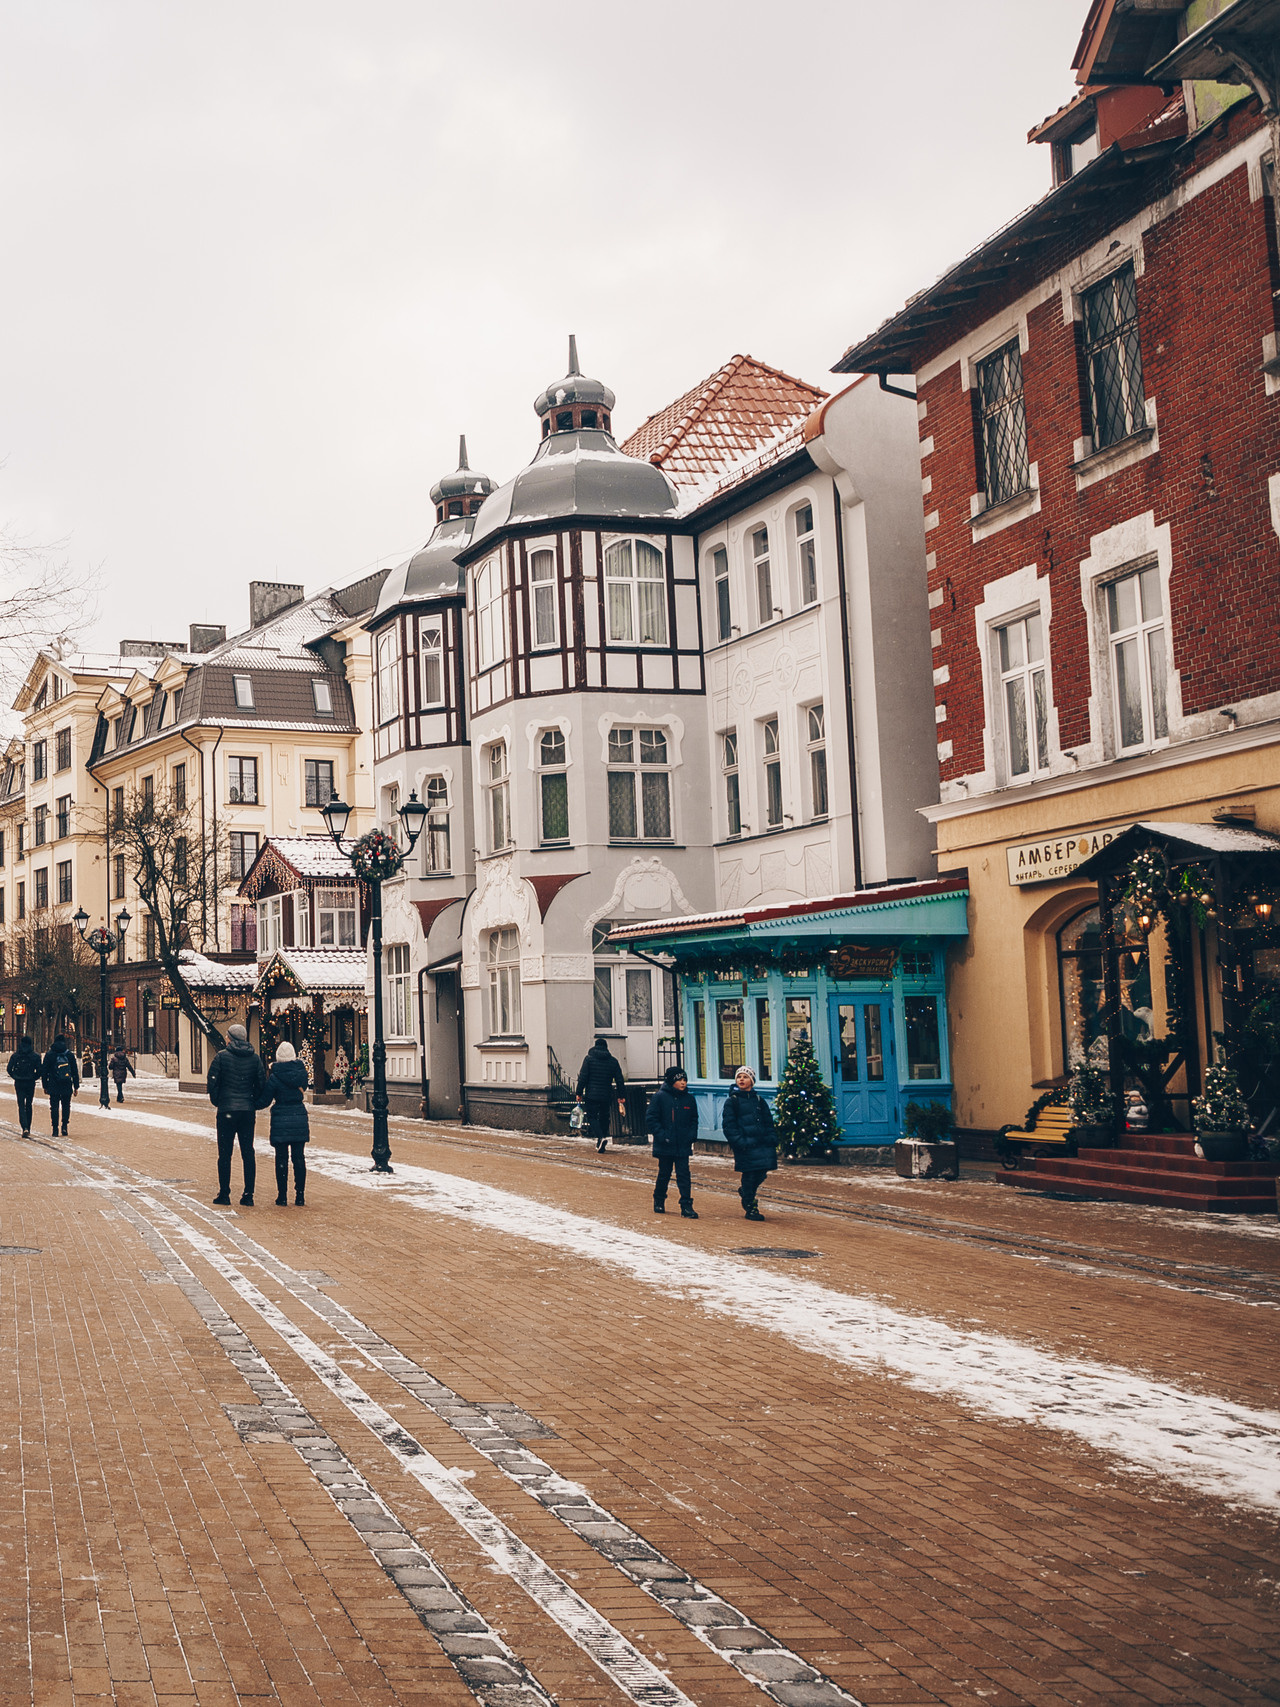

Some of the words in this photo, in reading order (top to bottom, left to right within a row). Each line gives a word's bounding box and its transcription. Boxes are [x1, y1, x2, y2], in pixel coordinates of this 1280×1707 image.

[1018, 840, 1076, 868] АМБЕР
[1091, 830, 1126, 854] АР
[1048, 863, 1081, 876] СЕРЕБР
